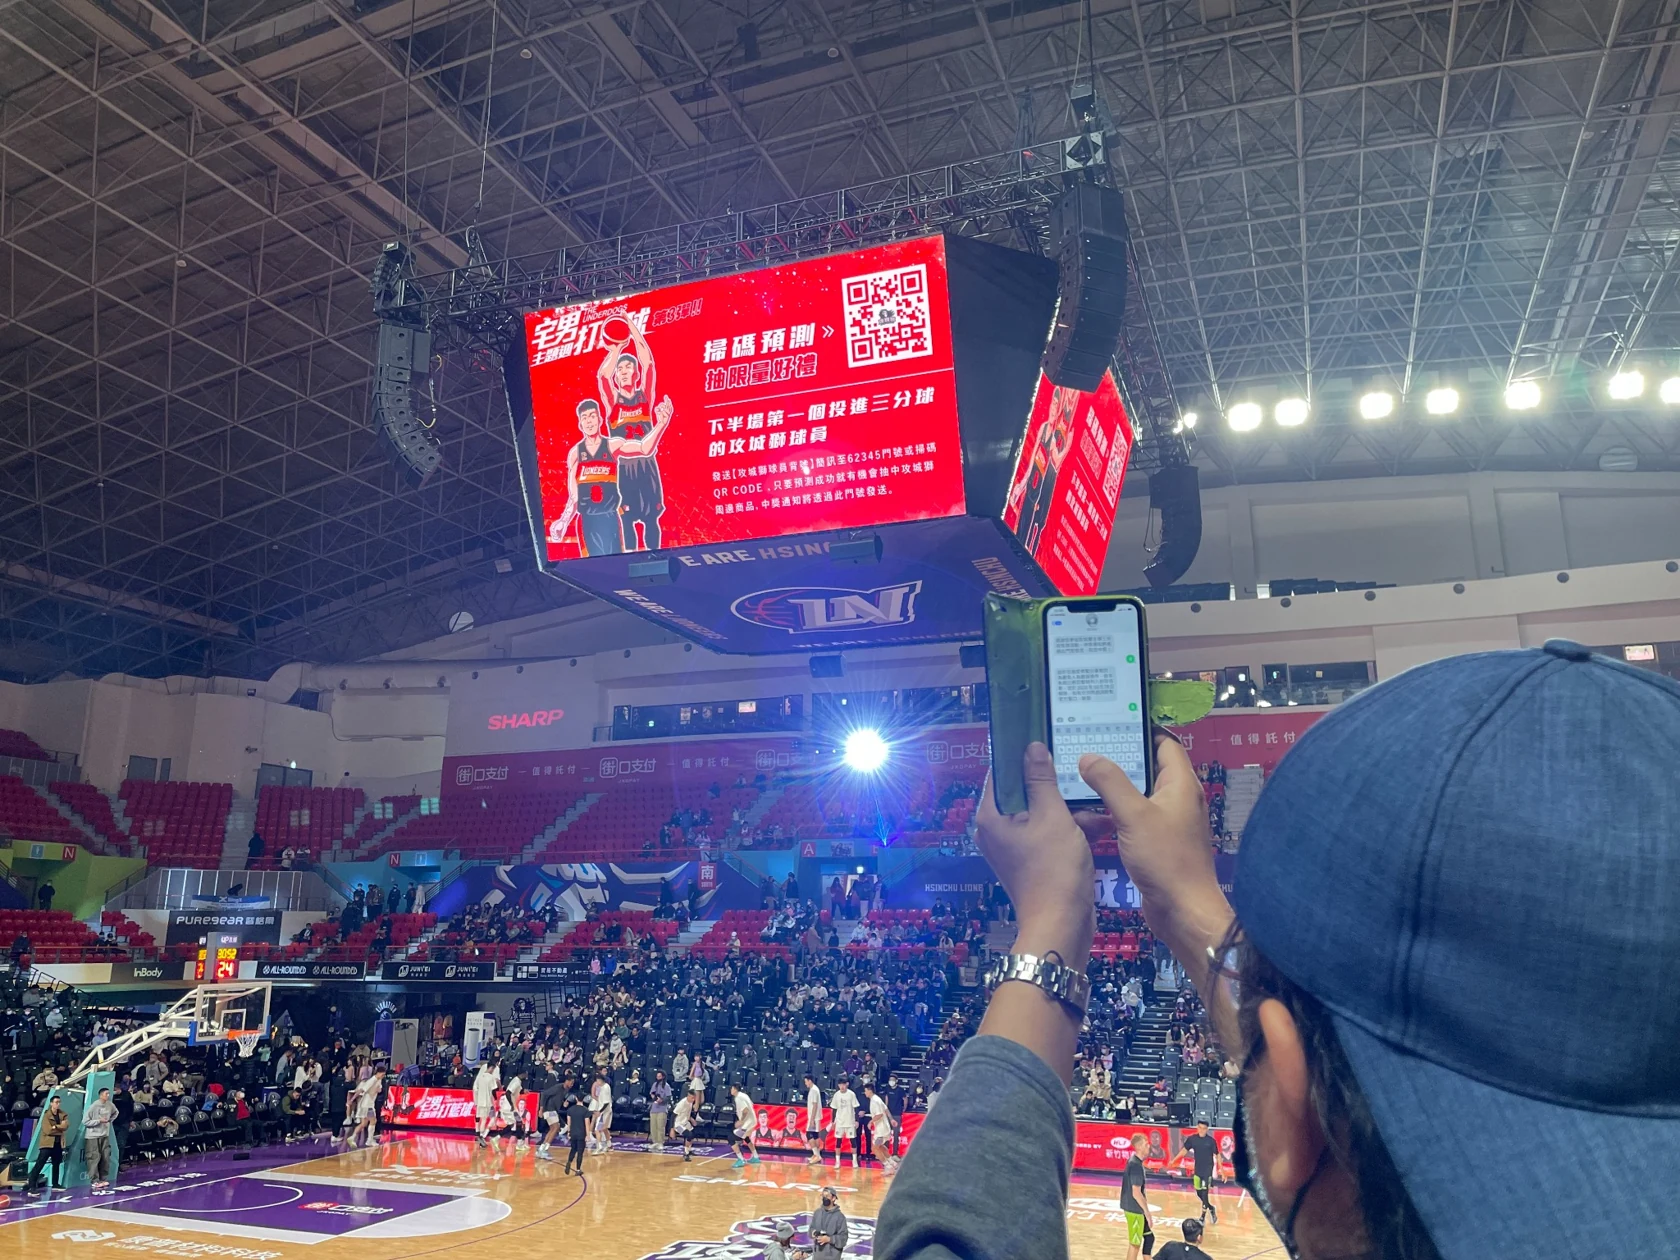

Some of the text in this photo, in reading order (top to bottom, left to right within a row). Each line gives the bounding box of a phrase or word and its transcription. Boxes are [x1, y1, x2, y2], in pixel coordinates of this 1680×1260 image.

[583, 304, 629, 323] UNDERDOGS
[532, 311, 582, 351] 宅男
[573, 307, 652, 356] 打球
[703, 322, 816, 363] 掃碼預測
[530, 342, 575, 368] 主題週
[705, 352, 818, 392] 抽限量好禮
[707, 386, 935, 435] 下半場第一個投進三分球
[708, 426, 828, 457] 的攻城獅球員
[713, 487, 728, 499] QR
[733, 483, 763, 495] CODE
[678, 555, 701, 567] E
[701, 549, 756, 566] ARE
[487, 709, 564, 730] SHARP
[1230, 731, 1296, 745] 值得託付
[532, 764, 576, 776] 值得託付
[600, 757, 656, 778] 街口支付
[682, 756, 730, 769] 值得託付
[456, 765, 509, 786] 街口支付
[64, 847, 75, 859] N
[804, 843, 815, 855] A
[390, 854, 400, 865] N
[701, 865, 715, 880] 南
[925, 883, 984, 892] HSINCHU LIONE
[133, 967, 163, 978] InBody
[217, 961, 234, 978] 24
[672, 1175, 859, 1193] SHARP
